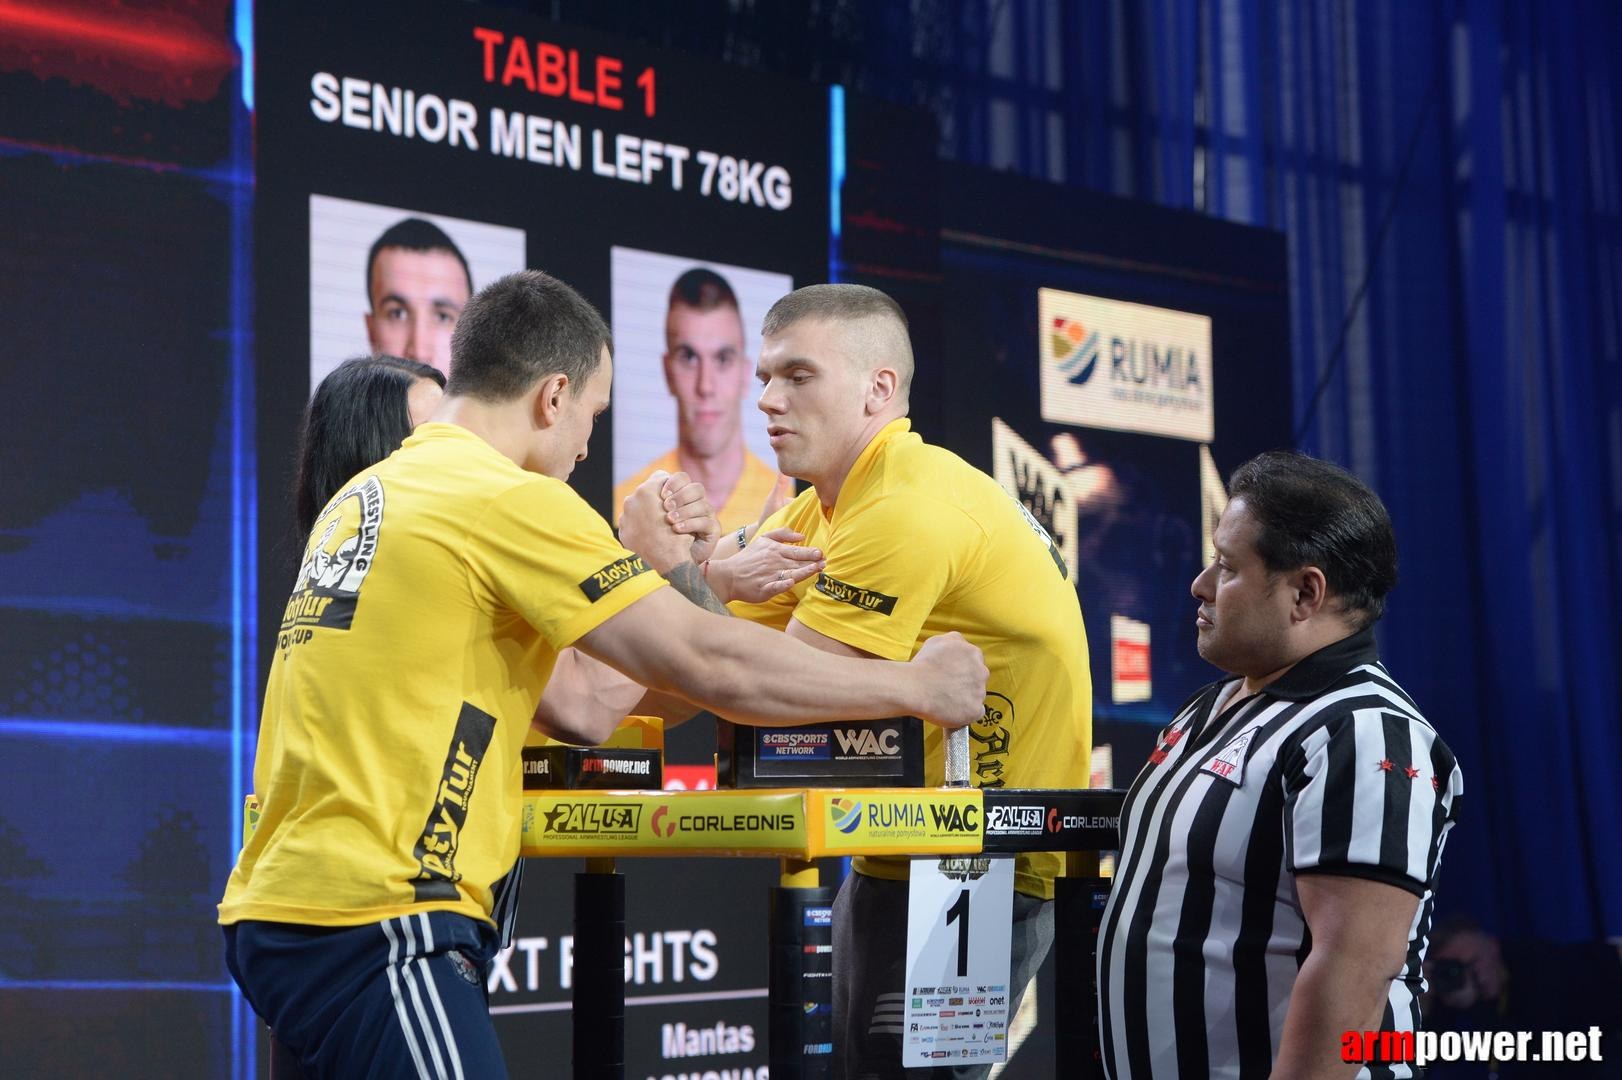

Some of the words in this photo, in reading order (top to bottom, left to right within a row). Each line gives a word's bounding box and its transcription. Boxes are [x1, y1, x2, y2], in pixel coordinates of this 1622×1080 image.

[473, 26, 624, 111] TABLE
[636, 66, 656, 118] 1
[310, 71, 479, 151] SENIOR
[490, 107, 582, 171] MEN
[592, 128, 690, 191] LEFT
[696, 150, 793, 211] 78KG
[1110, 337, 1203, 393] RUMIA
[776, 746, 815, 755] NETWORK
[833, 728, 901, 755] WAC
[582, 758, 650, 775] armpower.net
[679, 815, 795, 832] CORLEONIS
[868, 803, 926, 828] RUMIA
[929, 804, 979, 832] WAC
[945, 889, 970, 977] 1
[661, 1021, 756, 1059] Mantas
